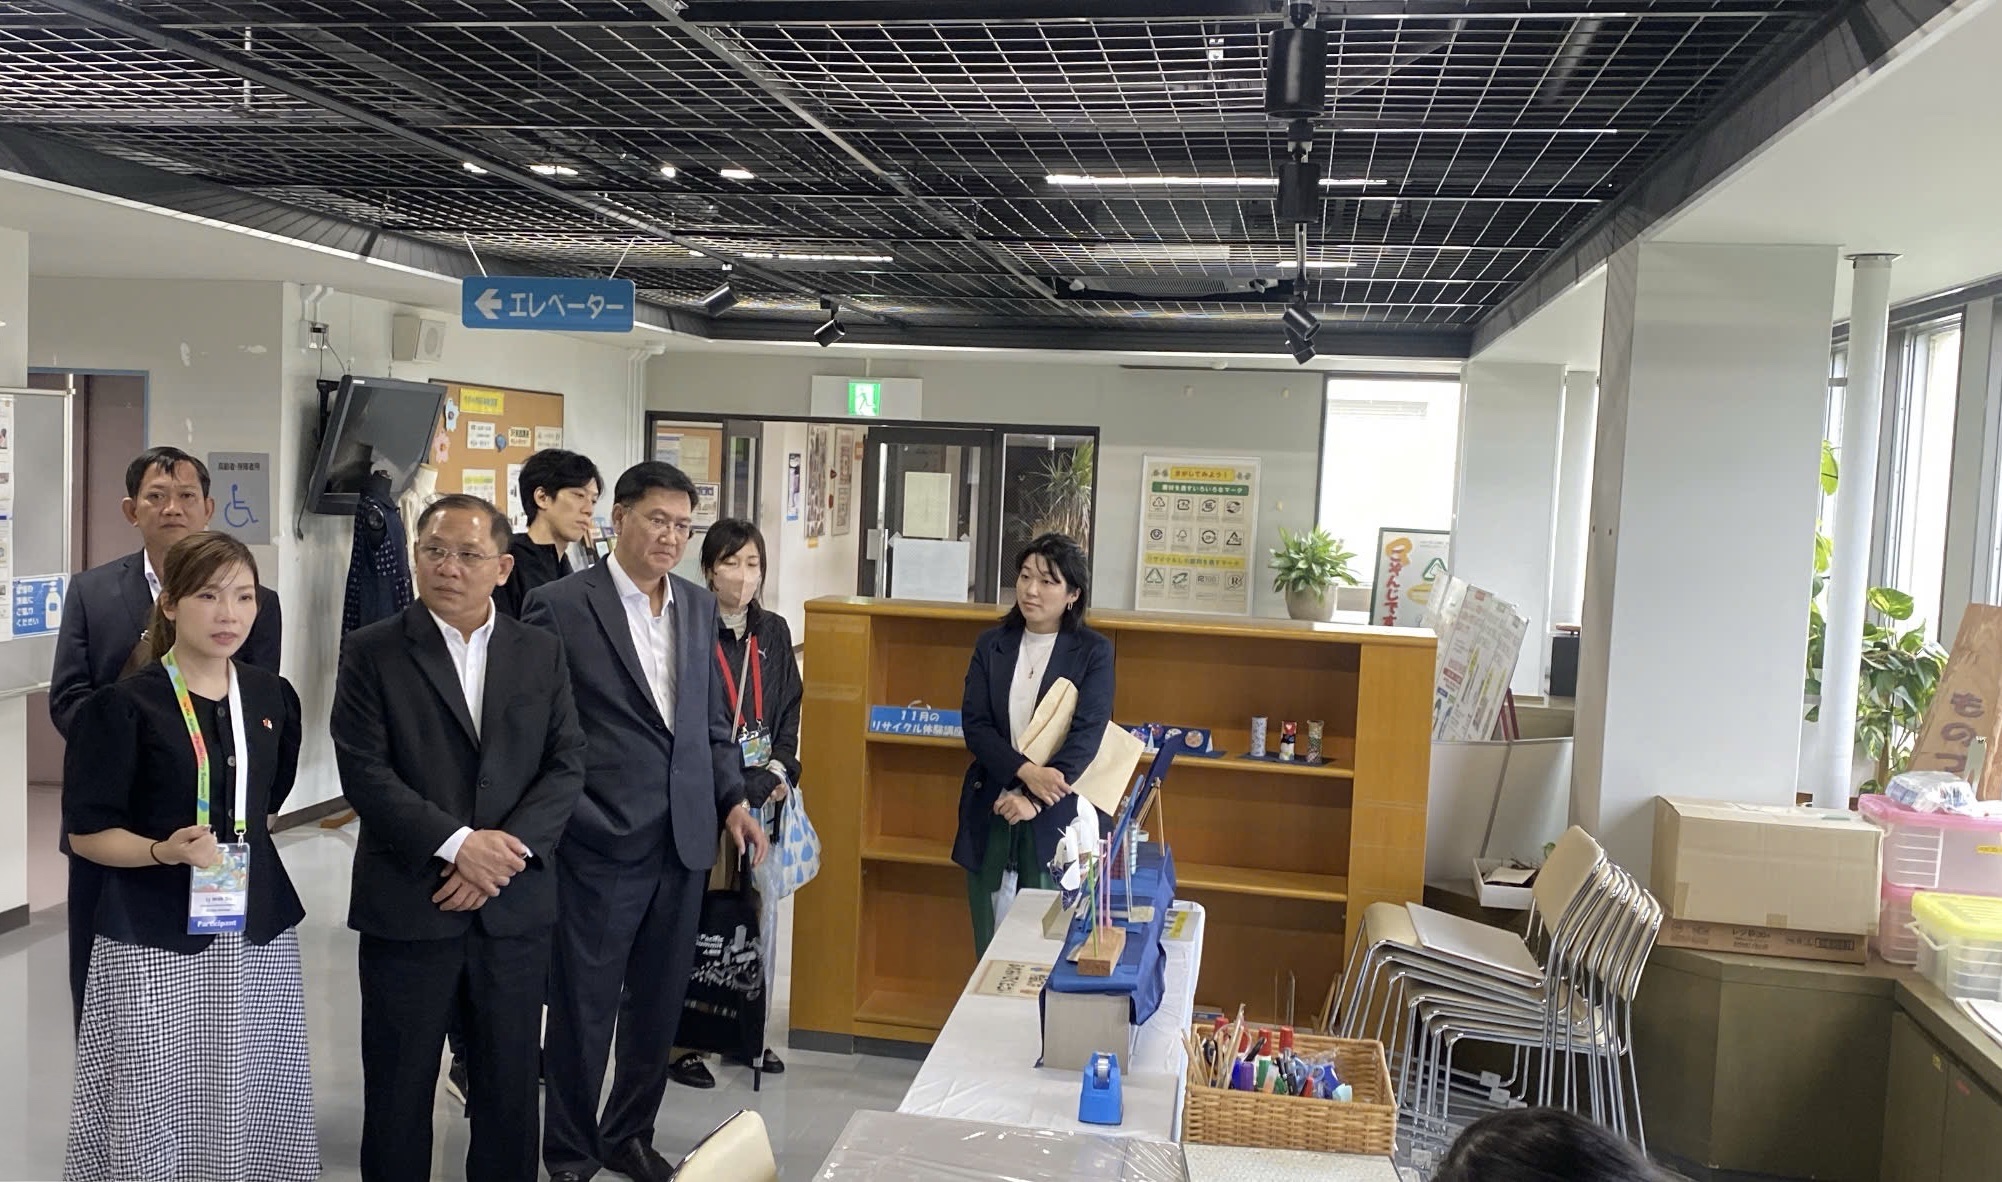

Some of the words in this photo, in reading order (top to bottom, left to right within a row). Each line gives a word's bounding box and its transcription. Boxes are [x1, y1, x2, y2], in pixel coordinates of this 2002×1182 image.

[509, 292, 624, 320] エレベーター
[16, 618, 40, 627] ください
[901, 710, 940, 722] 11月の
[872, 720, 965, 737] リサイクル体験講座
[197, 920, 237, 928] Participant
